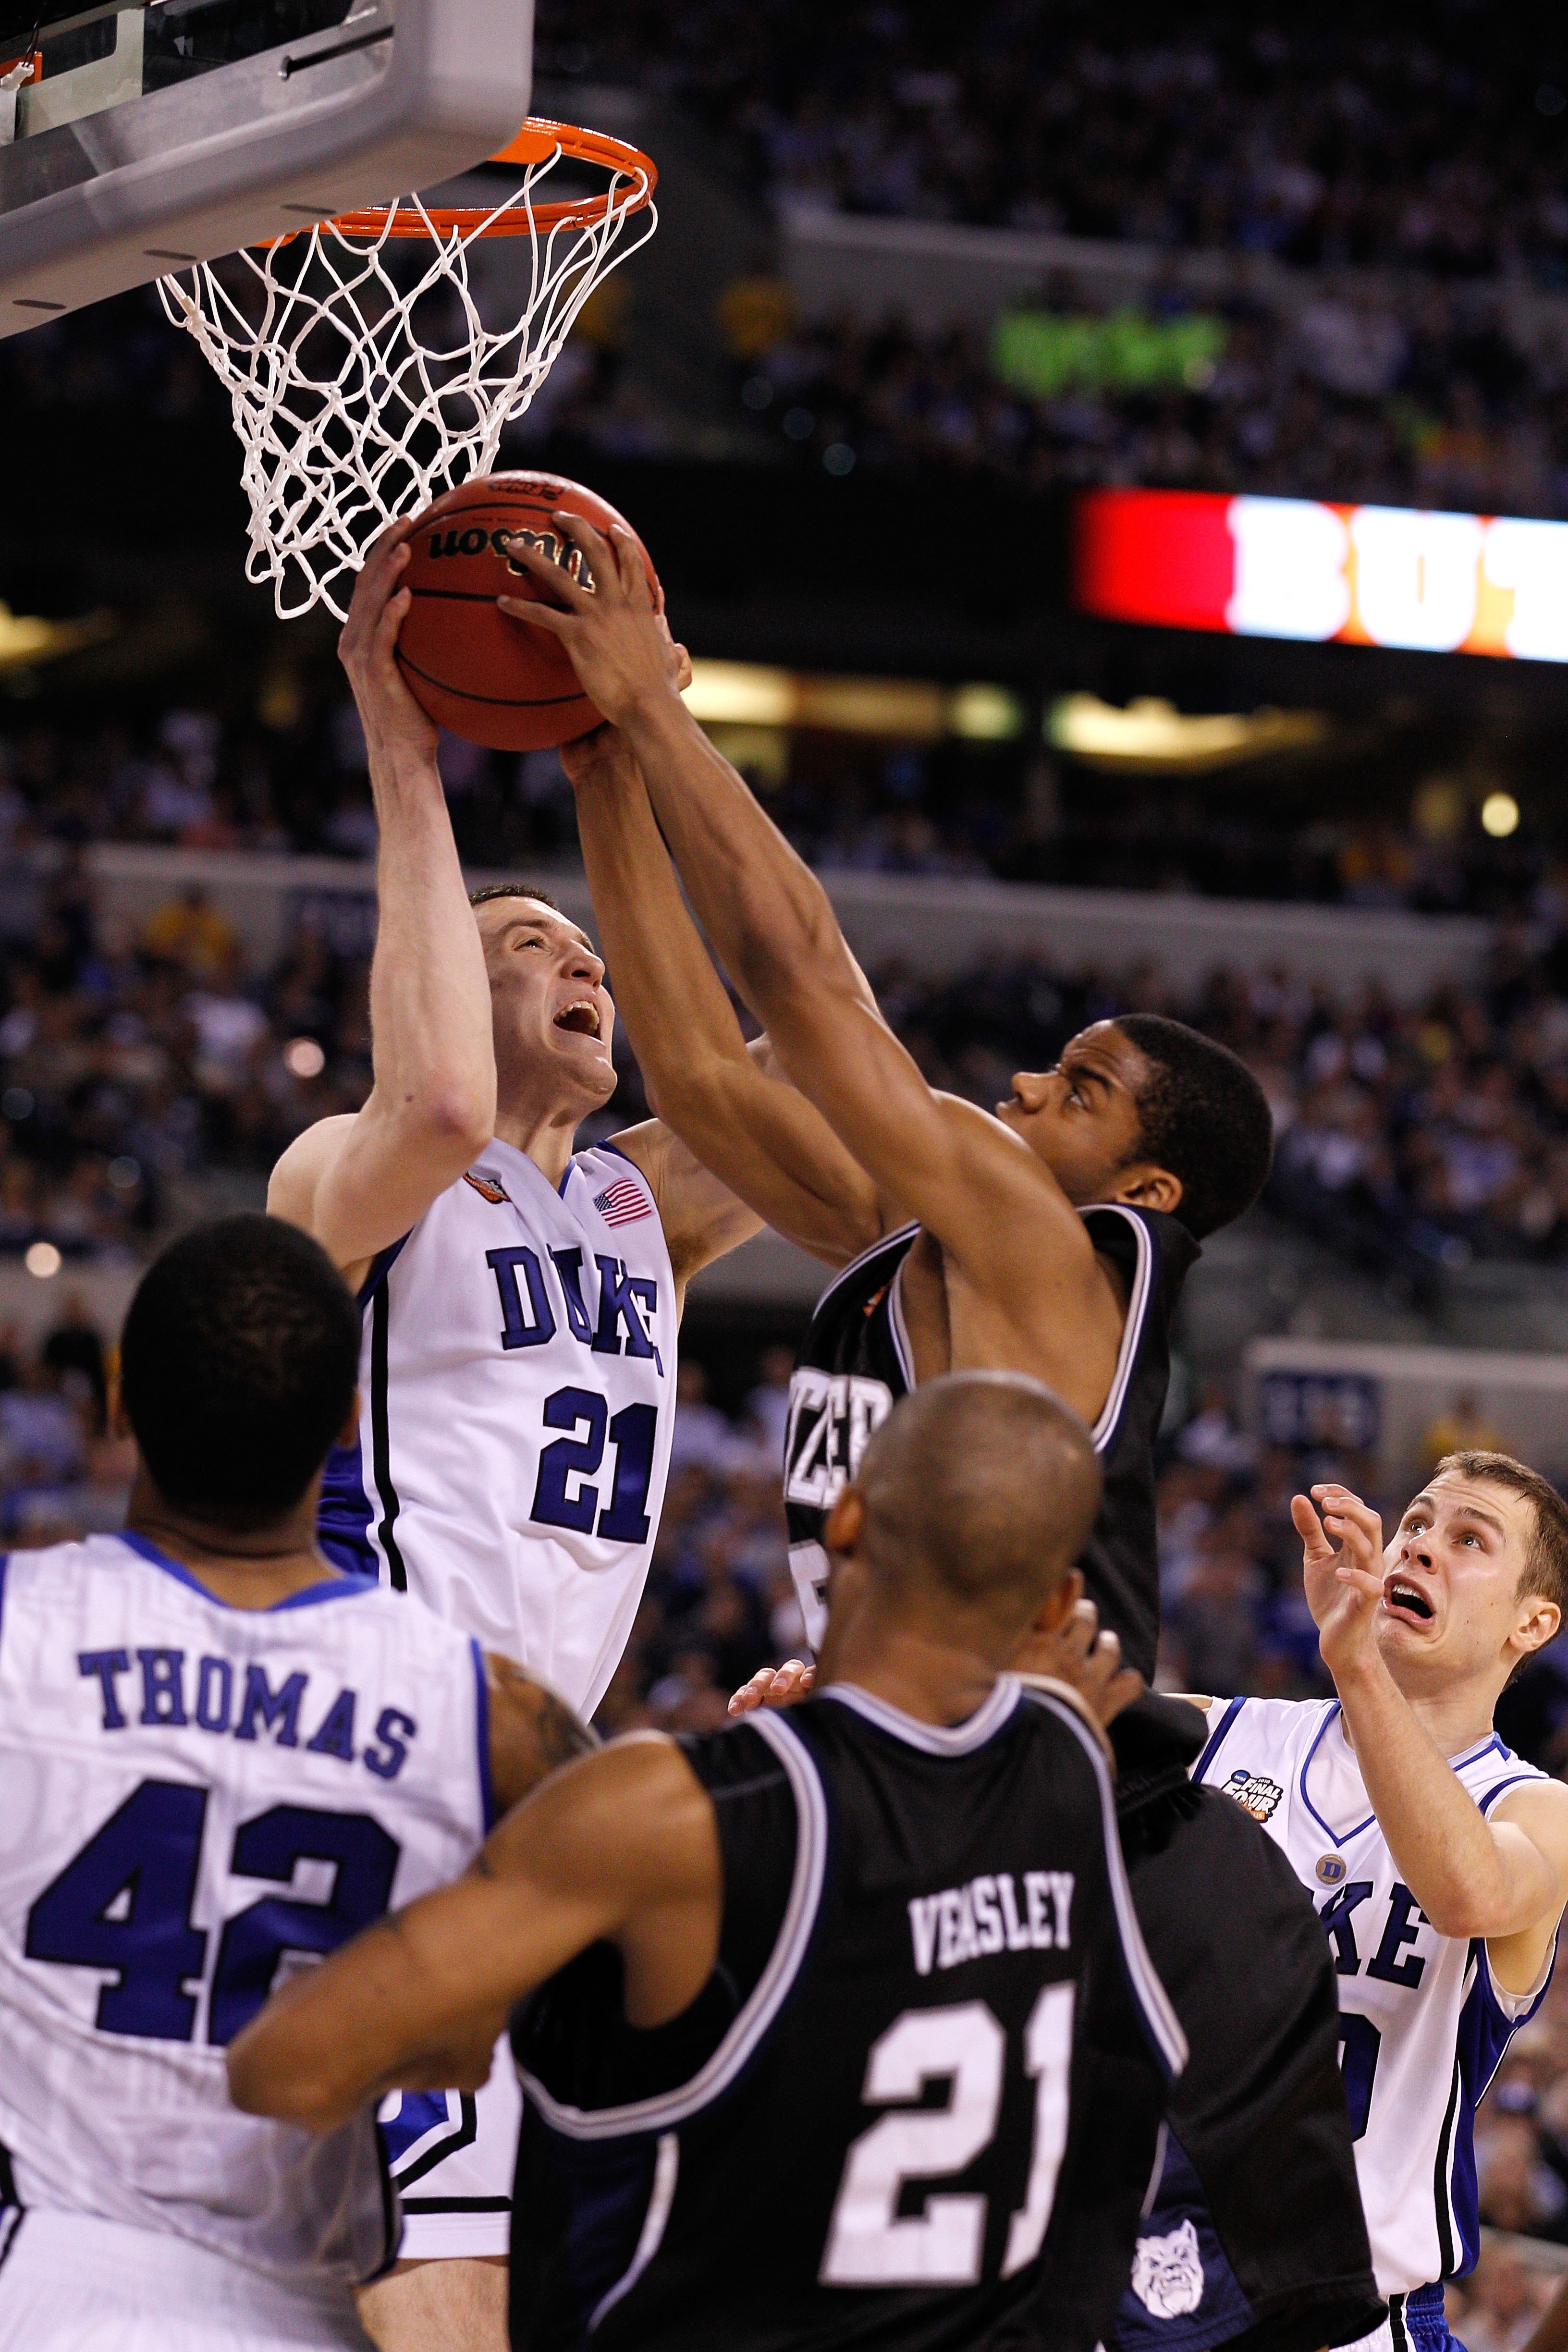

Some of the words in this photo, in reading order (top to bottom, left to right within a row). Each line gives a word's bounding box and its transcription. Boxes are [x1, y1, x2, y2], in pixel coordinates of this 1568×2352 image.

[486, 1243, 664, 1378] DUKE
[529, 1385, 658, 1544] 21
[78, 1648, 416, 1780] THOMAS
[1240, 1777, 1281, 1800] FINAL
[25, 1778, 401, 2046] 42
[907, 1870, 1076, 1976] VEASLEY
[1322, 1861, 1341, 1878] D
[818, 1980, 1077, 2288] 21
